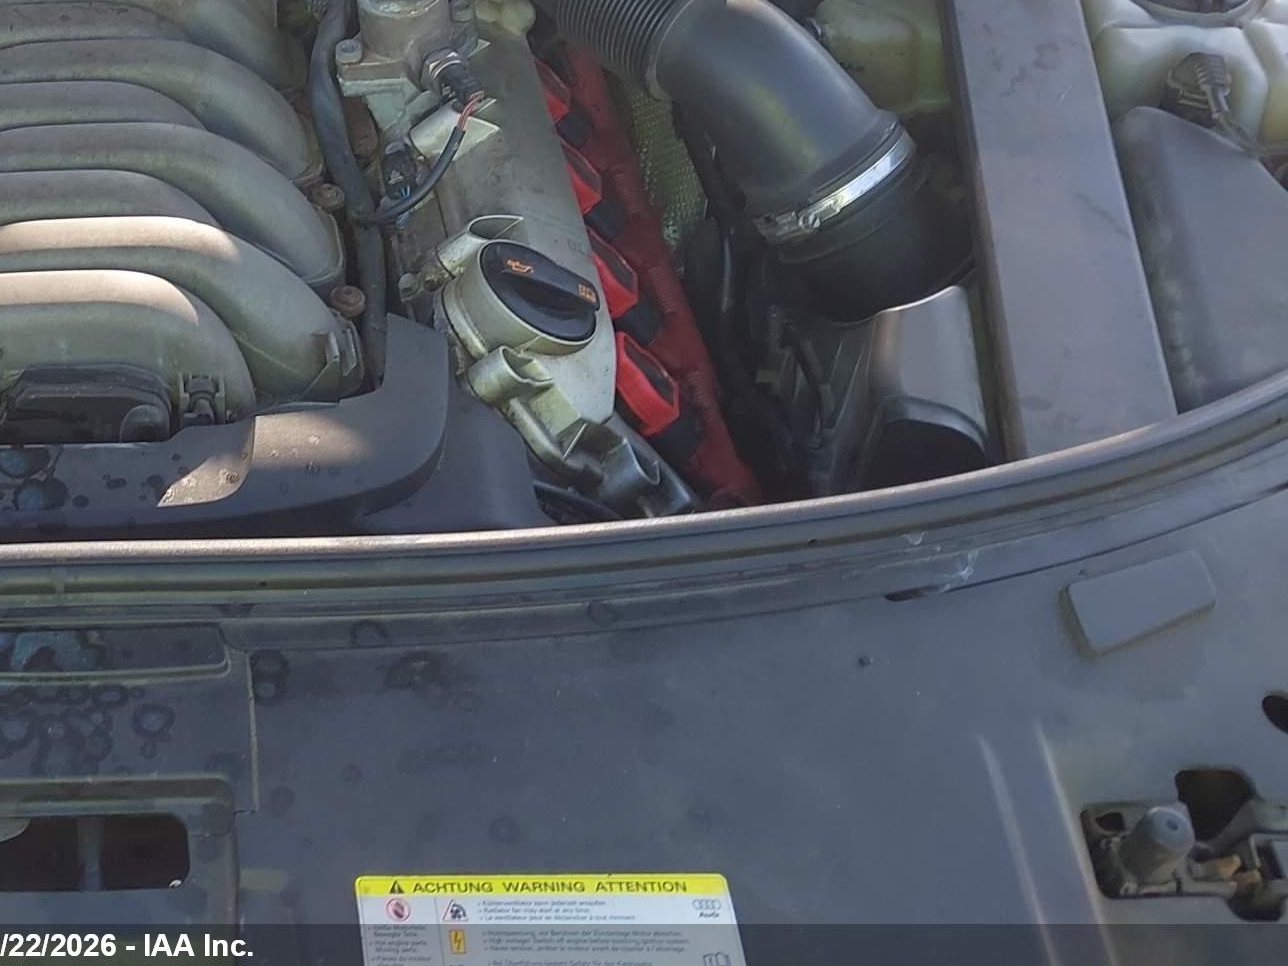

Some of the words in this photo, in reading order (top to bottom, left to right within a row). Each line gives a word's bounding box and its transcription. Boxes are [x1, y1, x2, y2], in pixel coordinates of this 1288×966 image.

[412, 881, 494, 893] ACHTUNG
[502, 881, 585, 893] WARNING
[595, 881, 687, 892] ATTENTION
